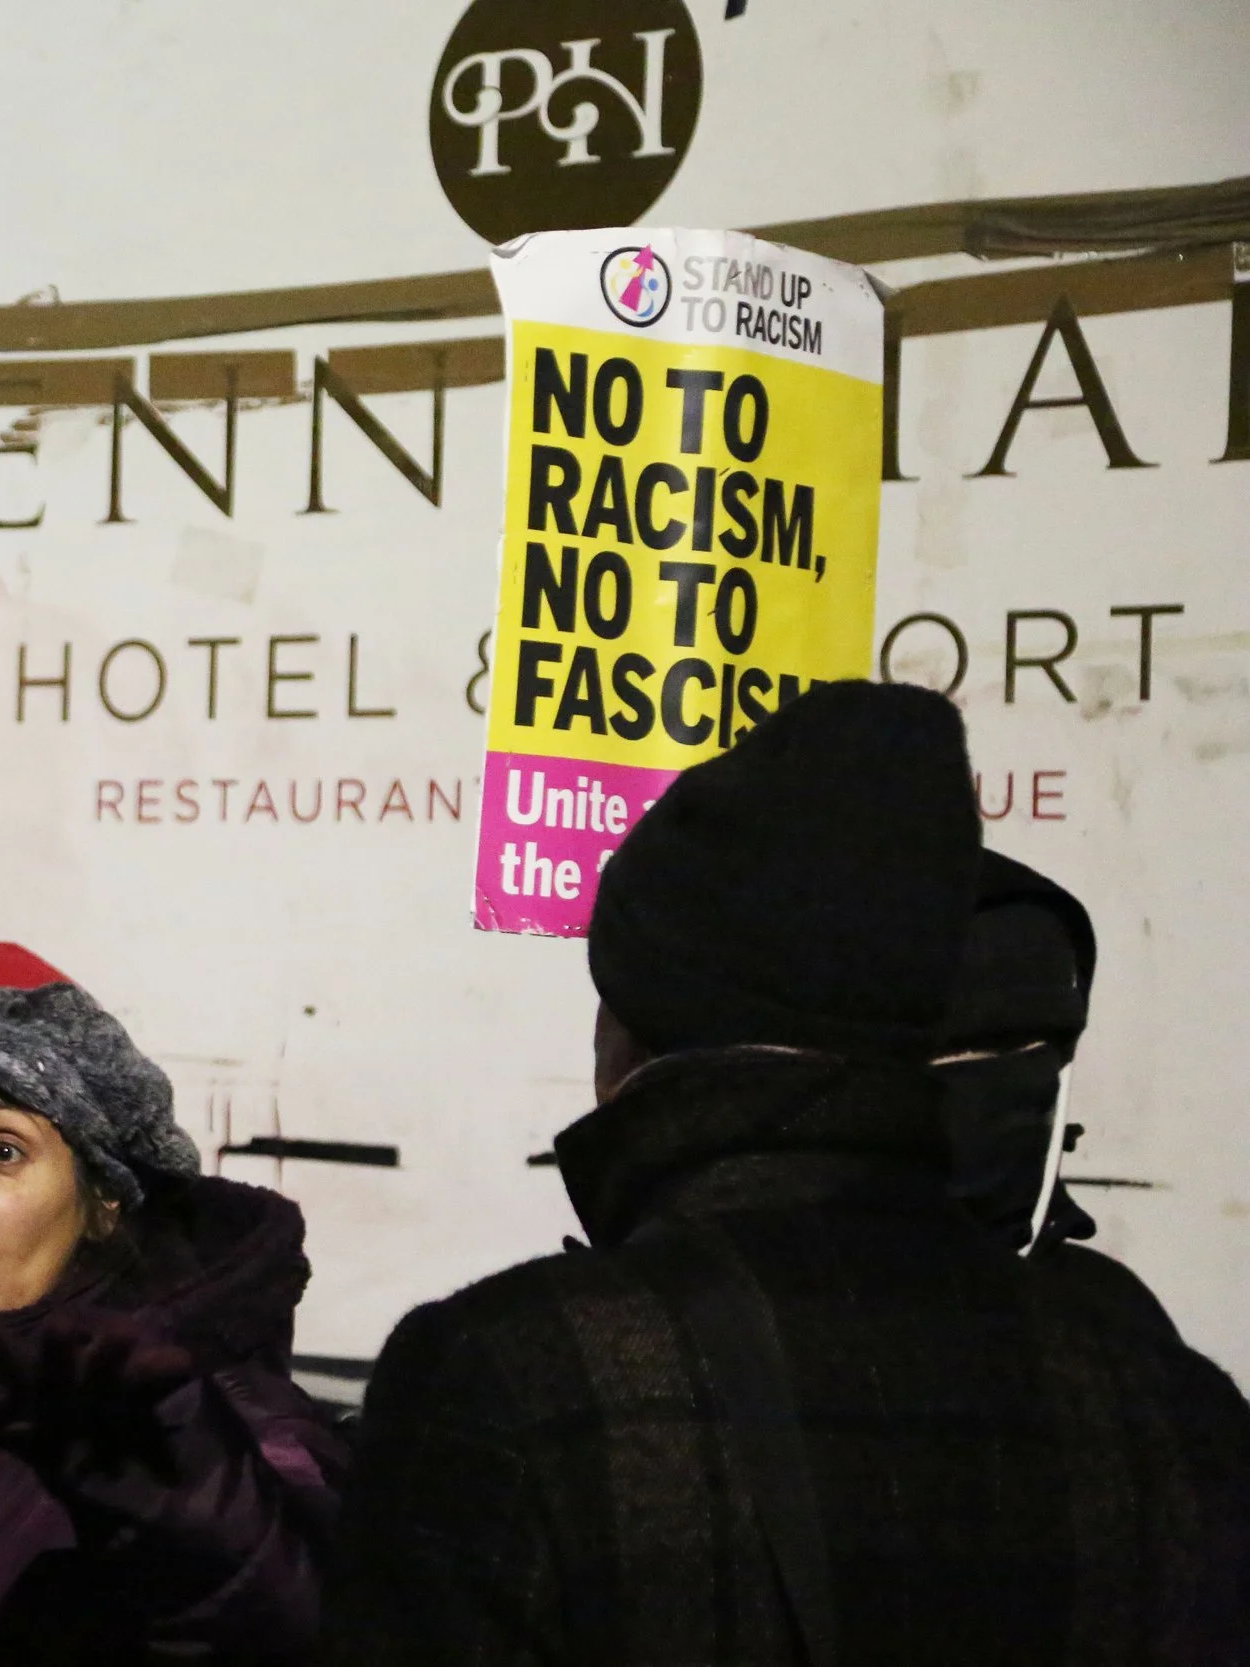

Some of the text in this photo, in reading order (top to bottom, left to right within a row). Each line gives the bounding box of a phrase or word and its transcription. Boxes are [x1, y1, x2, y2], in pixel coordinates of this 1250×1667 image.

[681, 254, 812, 310] STAND UP
[680, 296, 823, 355] TO RACISM
[532, 347, 644, 447] NO
[665, 368, 769, 463] TO
[526, 443, 827, 583] RACISM,
[520, 541, 759, 656] NO TO
[14, 632, 398, 723] HOTEL
[513, 638, 828, 749] FASCIS
[95, 776, 481, 824] RESTAURAN
[505, 769, 628, 835] Unite
[499, 841, 582, 900] the
